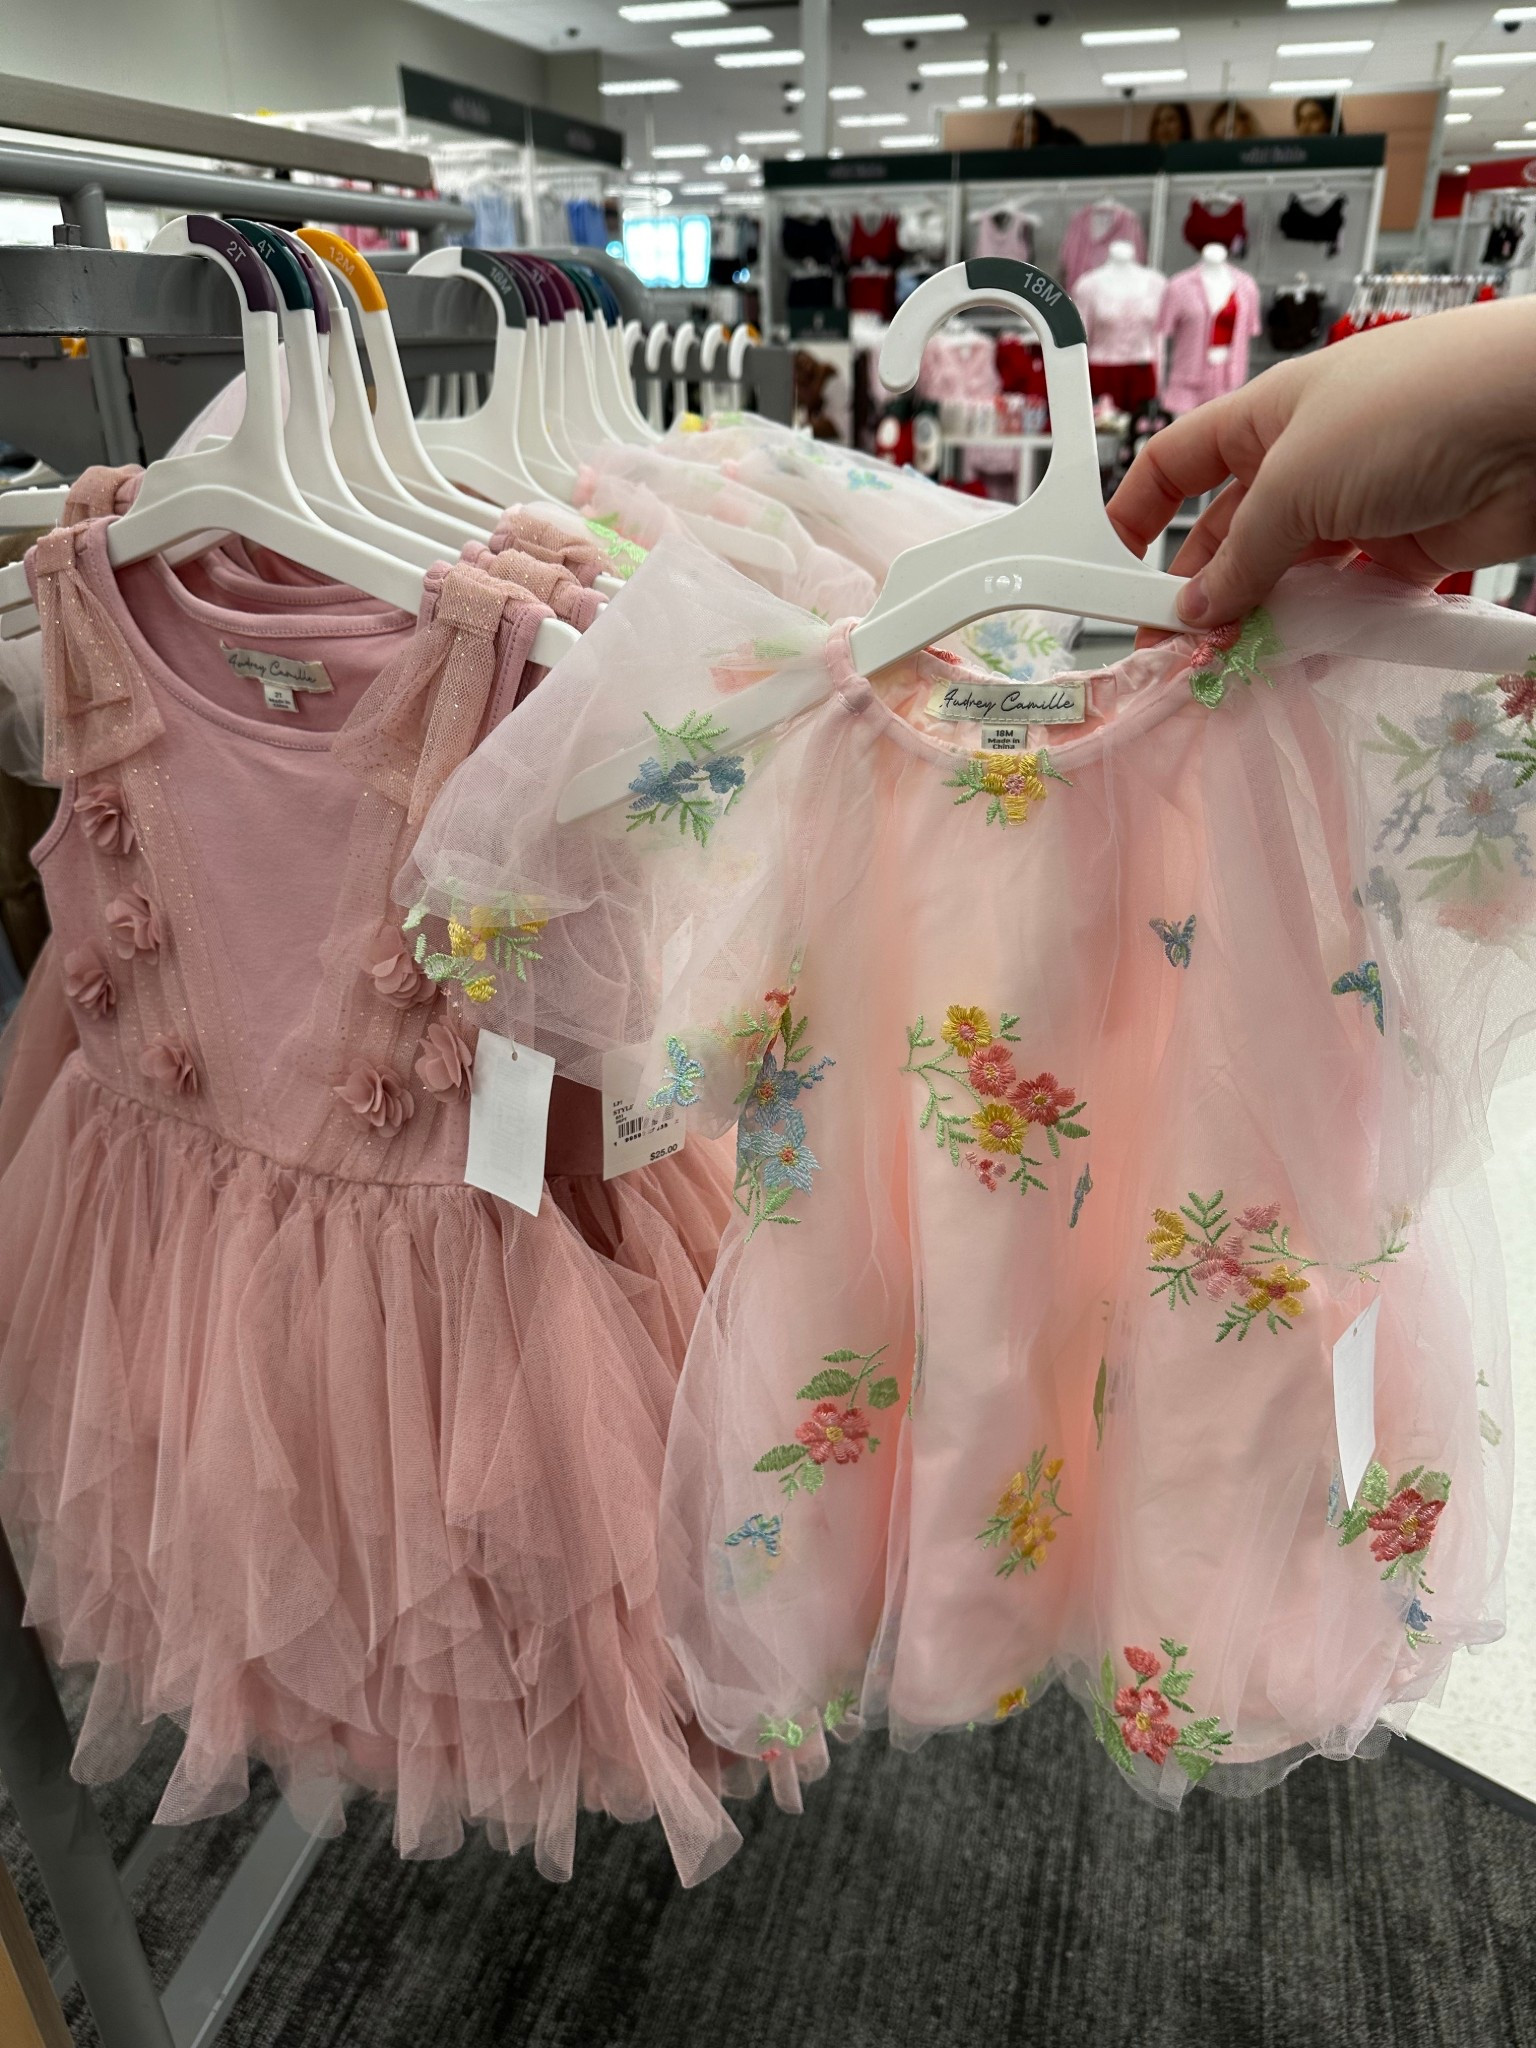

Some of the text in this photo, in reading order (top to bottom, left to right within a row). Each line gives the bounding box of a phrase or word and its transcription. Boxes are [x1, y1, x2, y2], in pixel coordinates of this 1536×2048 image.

[226, 241, 248, 262] 2T
[257, 239, 275, 259] 4T
[329, 247, 356, 276] 12M
[1023, 272, 1063, 307] 18M
[939, 688, 1075, 717] Audrey Camille
[649, 1143, 678, 1161] $25.00
